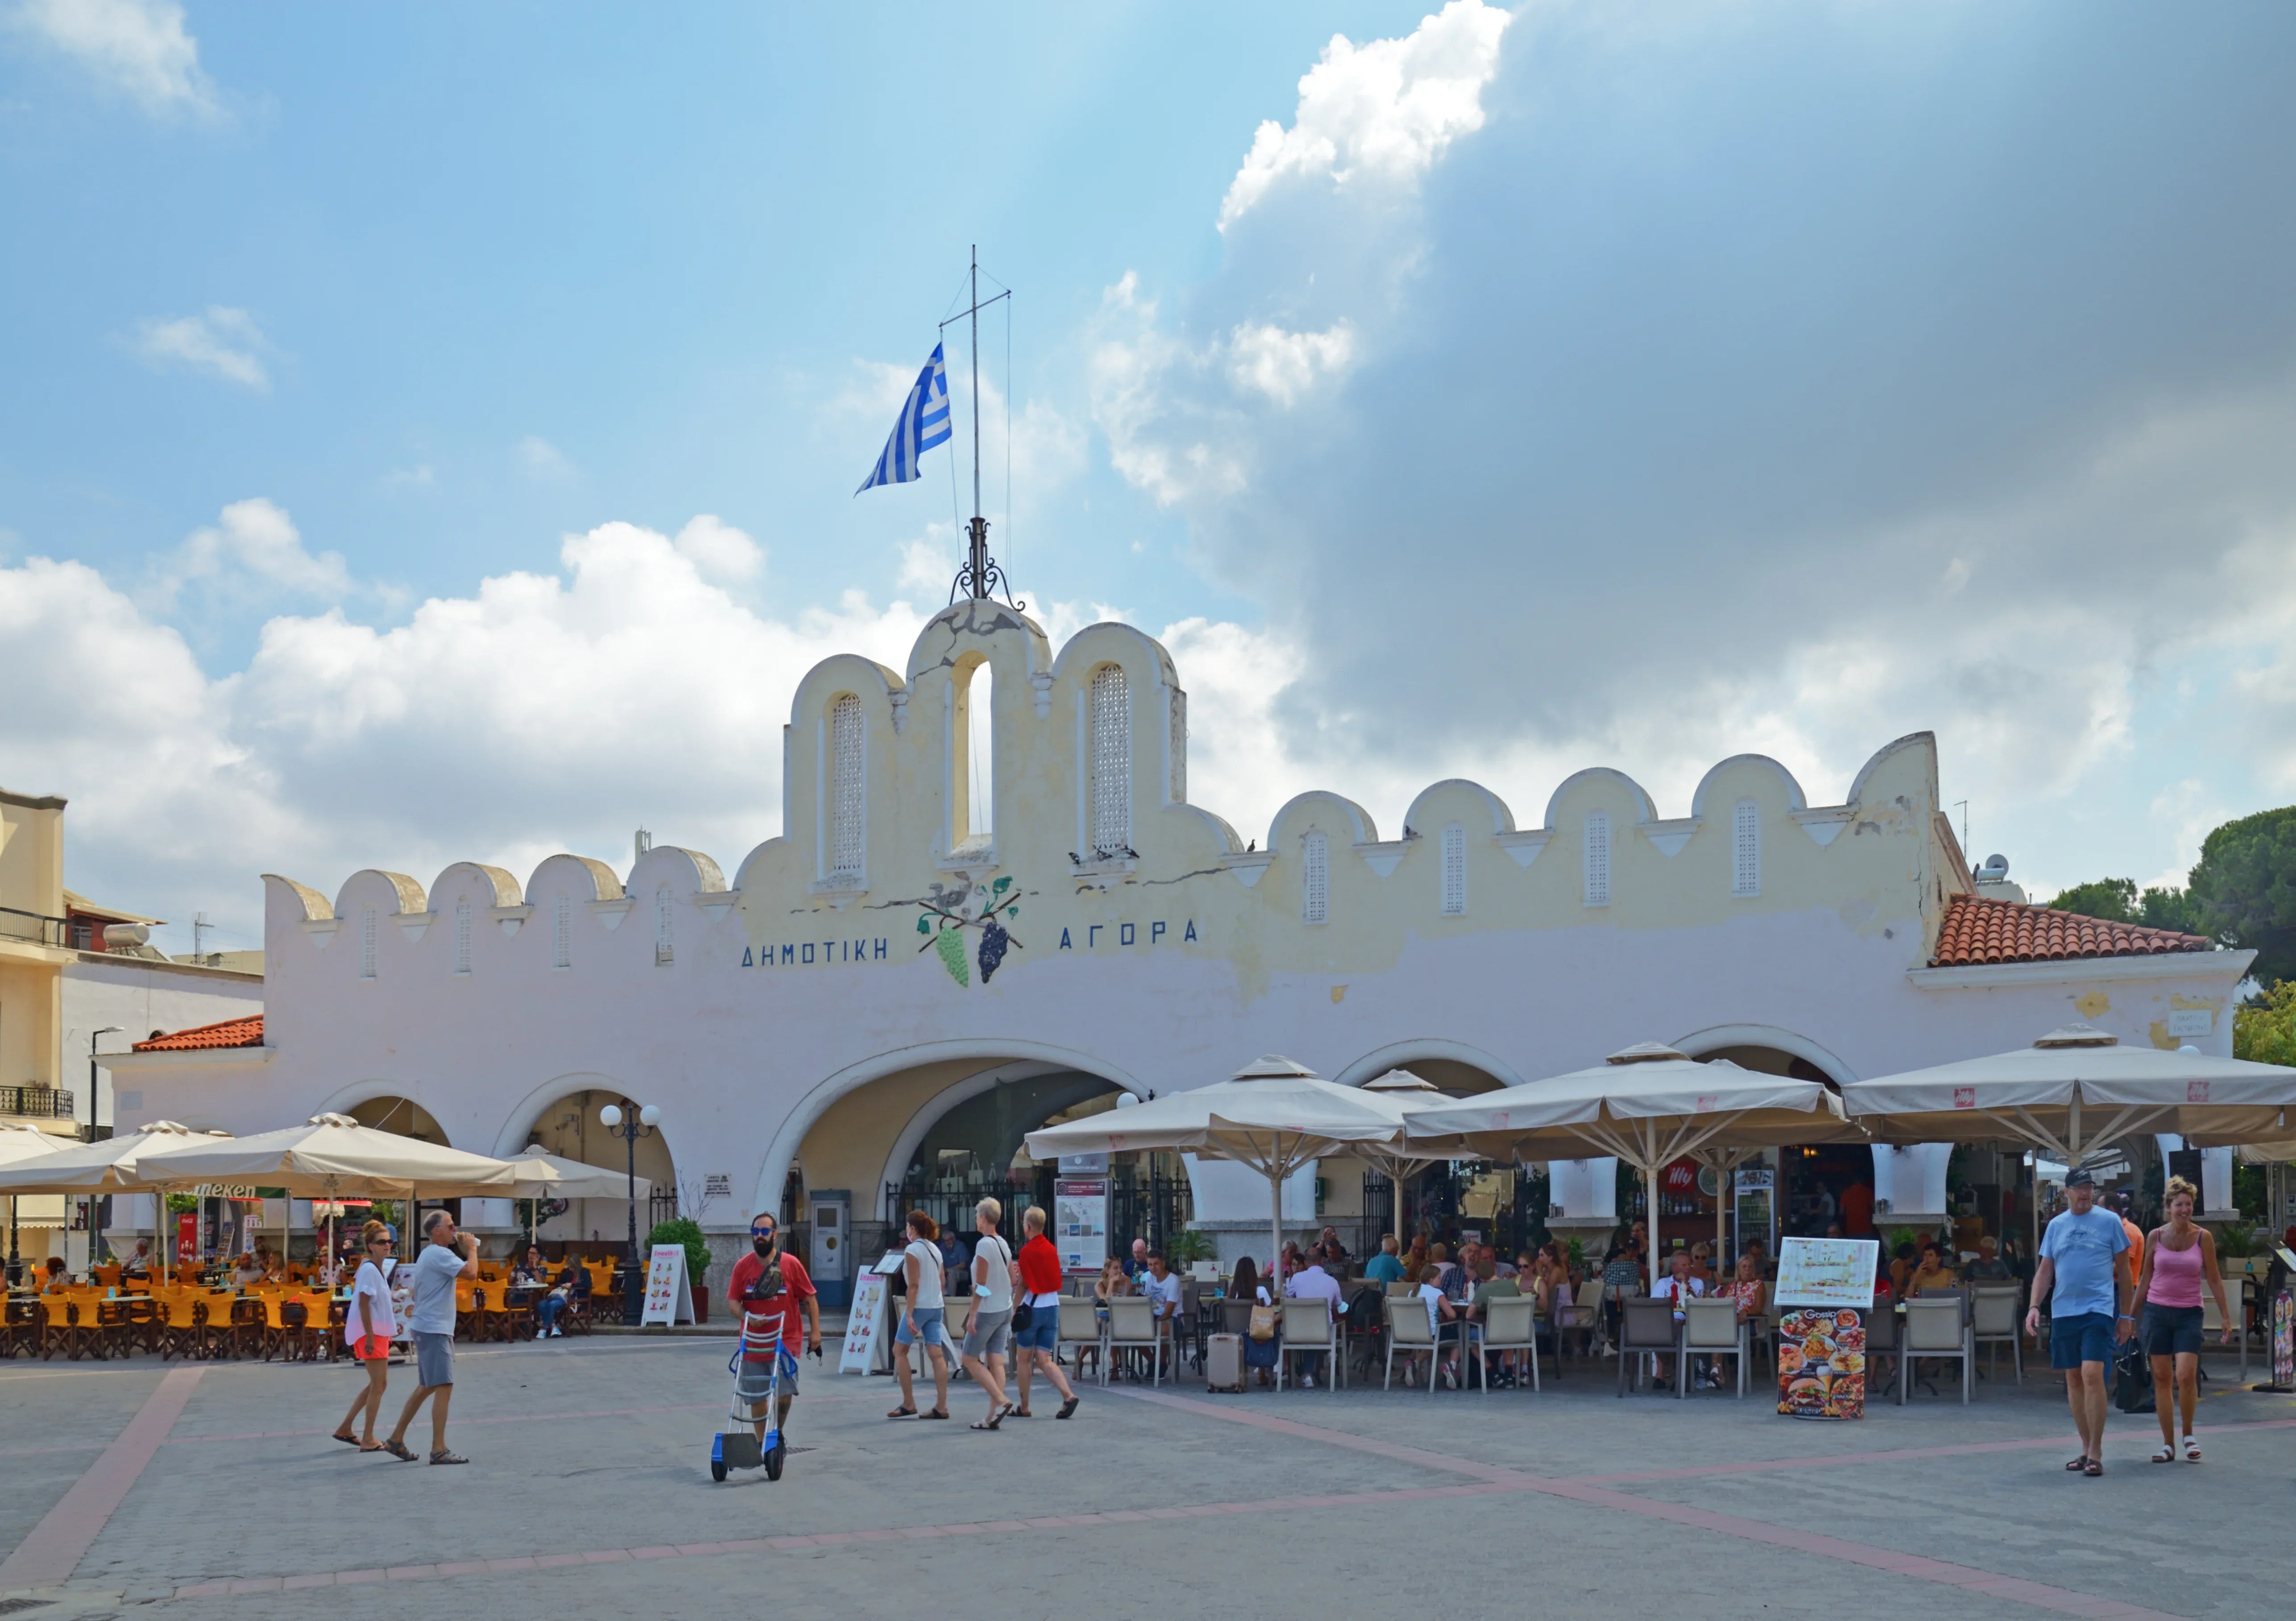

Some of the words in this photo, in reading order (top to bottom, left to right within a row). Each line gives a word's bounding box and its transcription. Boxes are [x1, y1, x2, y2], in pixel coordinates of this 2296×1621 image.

[742, 938, 887, 968] ΔΗΜΟΤΙΚΗ
[1059, 918, 1198, 950] ΑΓΟΡΑ
[1669, 1166, 1693, 1187] illy
[170, 1183, 256, 1198] ineken
[1804, 1309, 1836, 1319] Gossip
